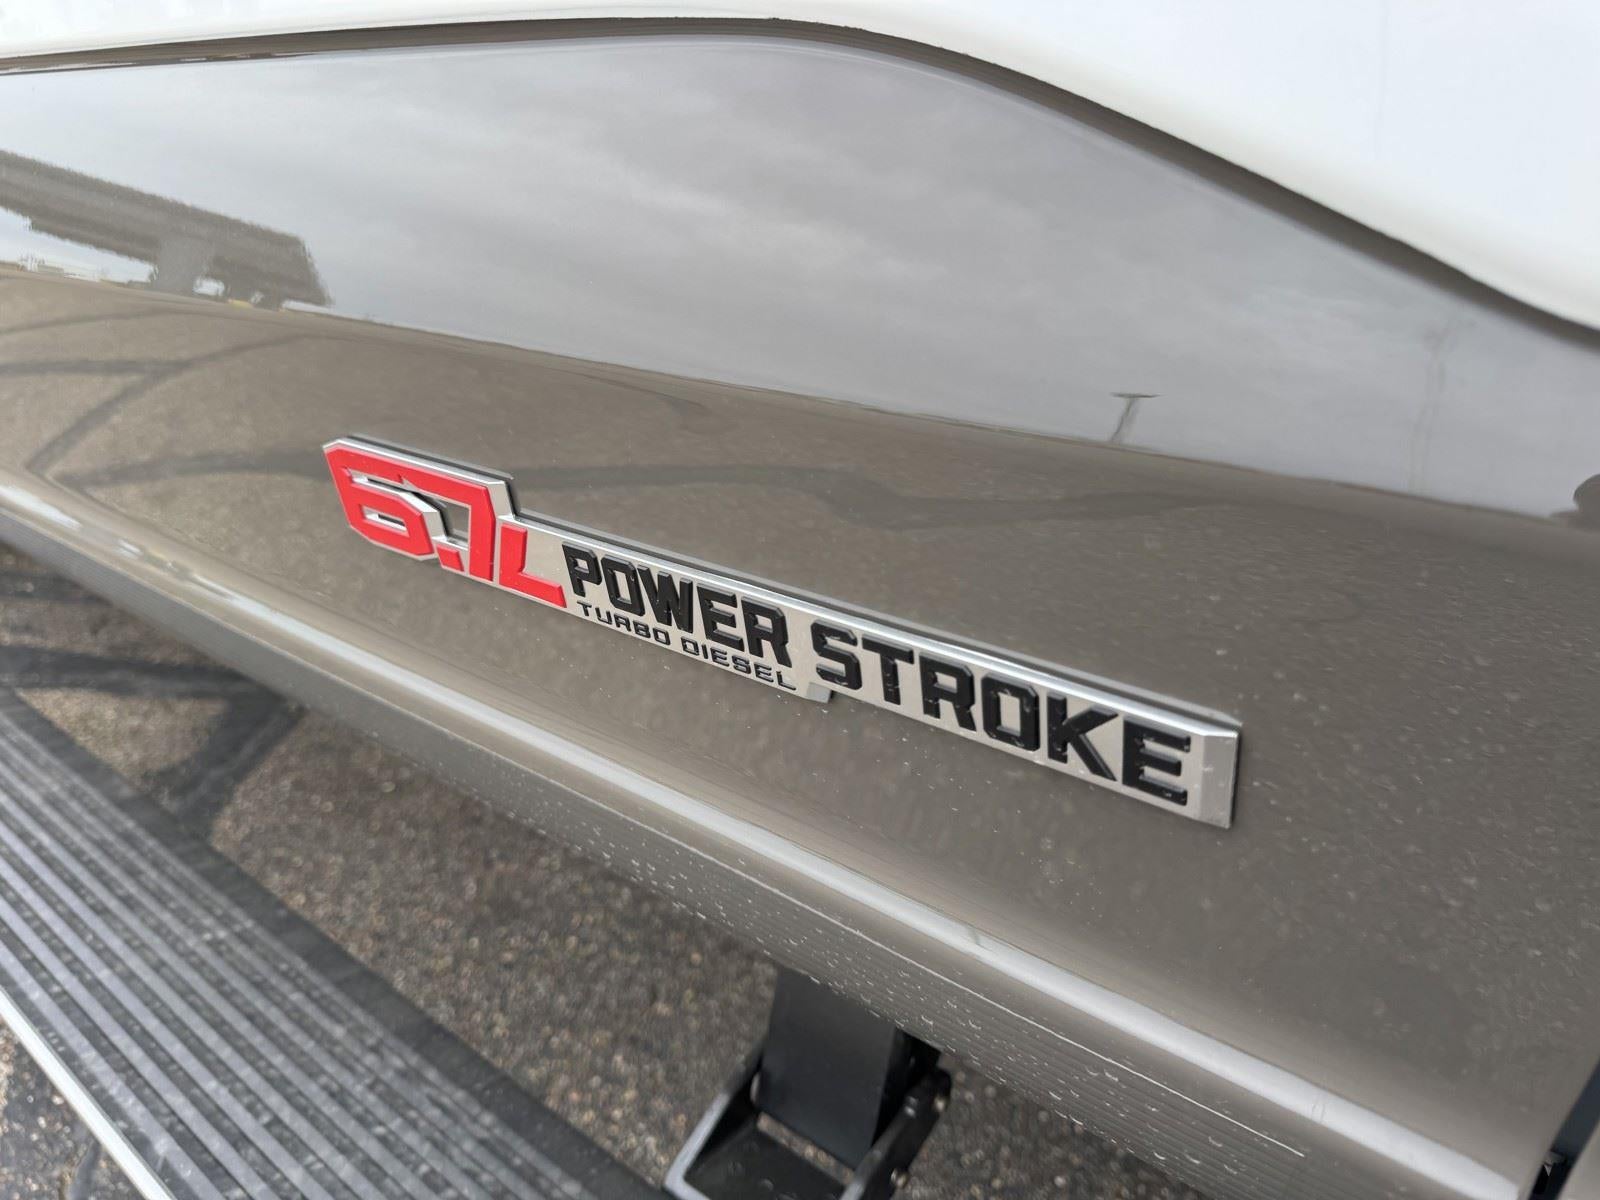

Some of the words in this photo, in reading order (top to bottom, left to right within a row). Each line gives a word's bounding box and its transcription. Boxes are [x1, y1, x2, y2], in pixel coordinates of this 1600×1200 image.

[562, 541, 792, 668] POWER
[811, 621, 1191, 806] STROKE
[576, 601, 672, 646] TURBO
[682, 638, 797, 691] DIESEL
